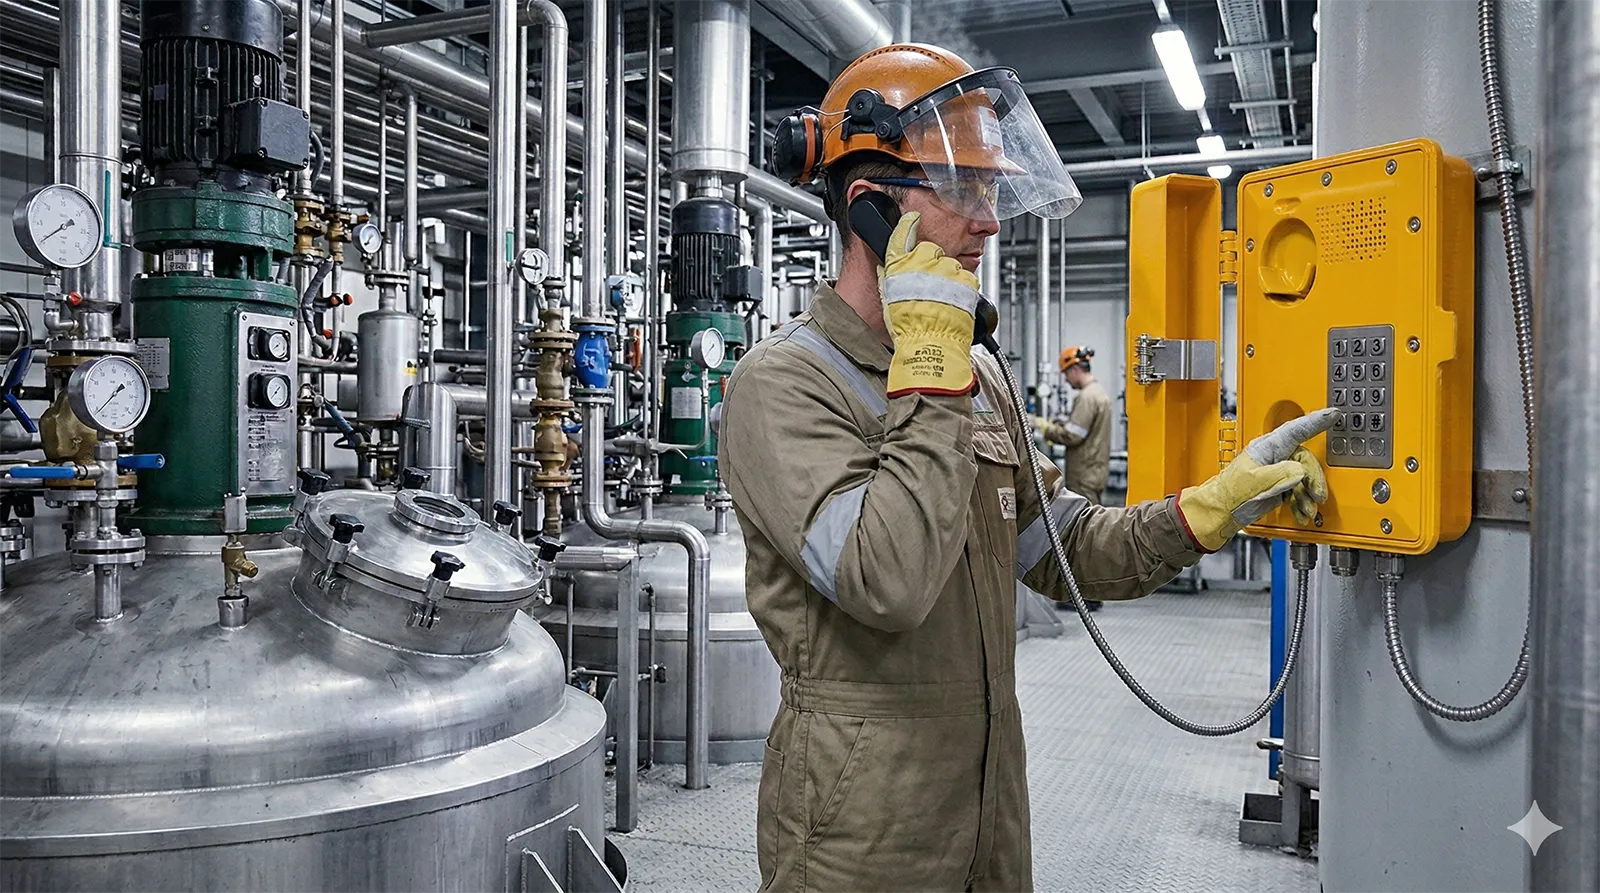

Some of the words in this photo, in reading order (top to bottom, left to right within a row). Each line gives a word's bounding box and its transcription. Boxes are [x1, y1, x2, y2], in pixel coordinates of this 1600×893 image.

[1335, 341, 1341, 354] 1
[1353, 339, 1361, 353] 2
[1372, 338, 1381, 352] 3
[1334, 365, 1342, 378] 4
[1353, 365, 1361, 378] 5
[1372, 364, 1380, 377] 6
[1334, 390, 1341, 403] 7
[1353, 389, 1361, 403] 8
[1372, 389, 1380, 403] 9
[1353, 414, 1361, 428] 0
[1371, 414, 1381, 429] #
